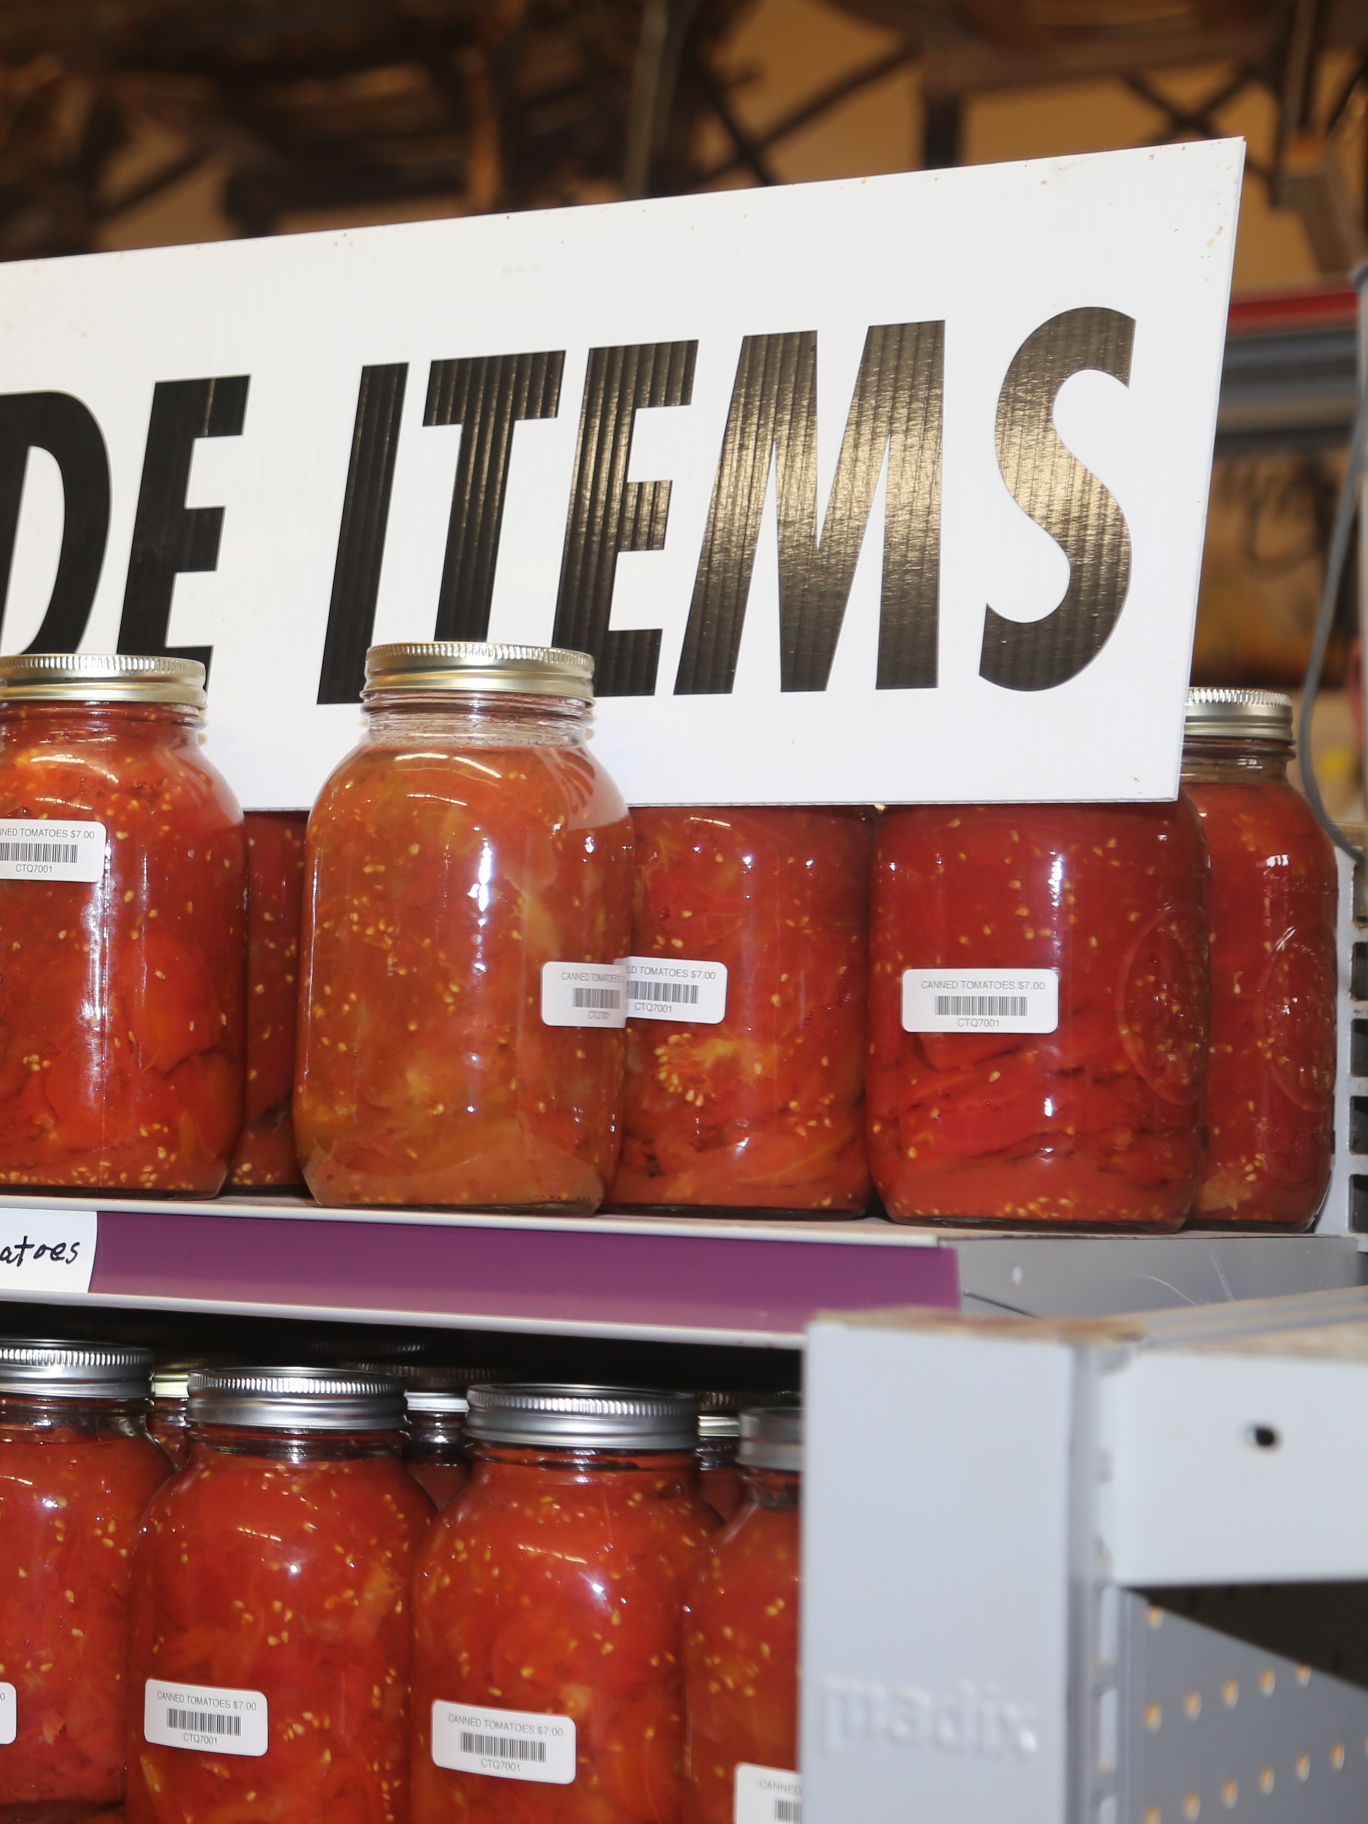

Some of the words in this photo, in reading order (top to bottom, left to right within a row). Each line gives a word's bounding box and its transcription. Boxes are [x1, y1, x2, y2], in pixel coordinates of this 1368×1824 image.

[316, 306, 1137, 706] ITEMS
[20, 828, 68, 838] TOMATOES
[70, 830, 95, 839] $7.00
[15, 864, 53, 873] CTQ7001
[562, 971, 589, 981] CANNED
[639, 966, 689, 978] TOMATOES
[691, 970, 716, 980] $7.00
[921, 980, 959, 990] CANNED
[961, 980, 1016, 990] TOMATOES
[1018, 981, 1046, 991] $7.00
[634, 1002, 673, 1013] CTQ7001
[957, 1018, 1001, 1028] CTQ7001
[157, 1691, 185, 1703] CANNED
[186, 1695, 231, 1709] TOMATOES
[233, 1700, 257, 1711] $7.00
[448, 1713, 482, 1727] CANNED
[483, 1719, 535, 1734] TOMATOES
[537, 1726, 564, 1737] $7.00
[183, 1733, 218, 1746] CTQ7001
[481, 1758, 521, 1772] CTQ7001
[759, 1780, 802, 1796] CANNED
